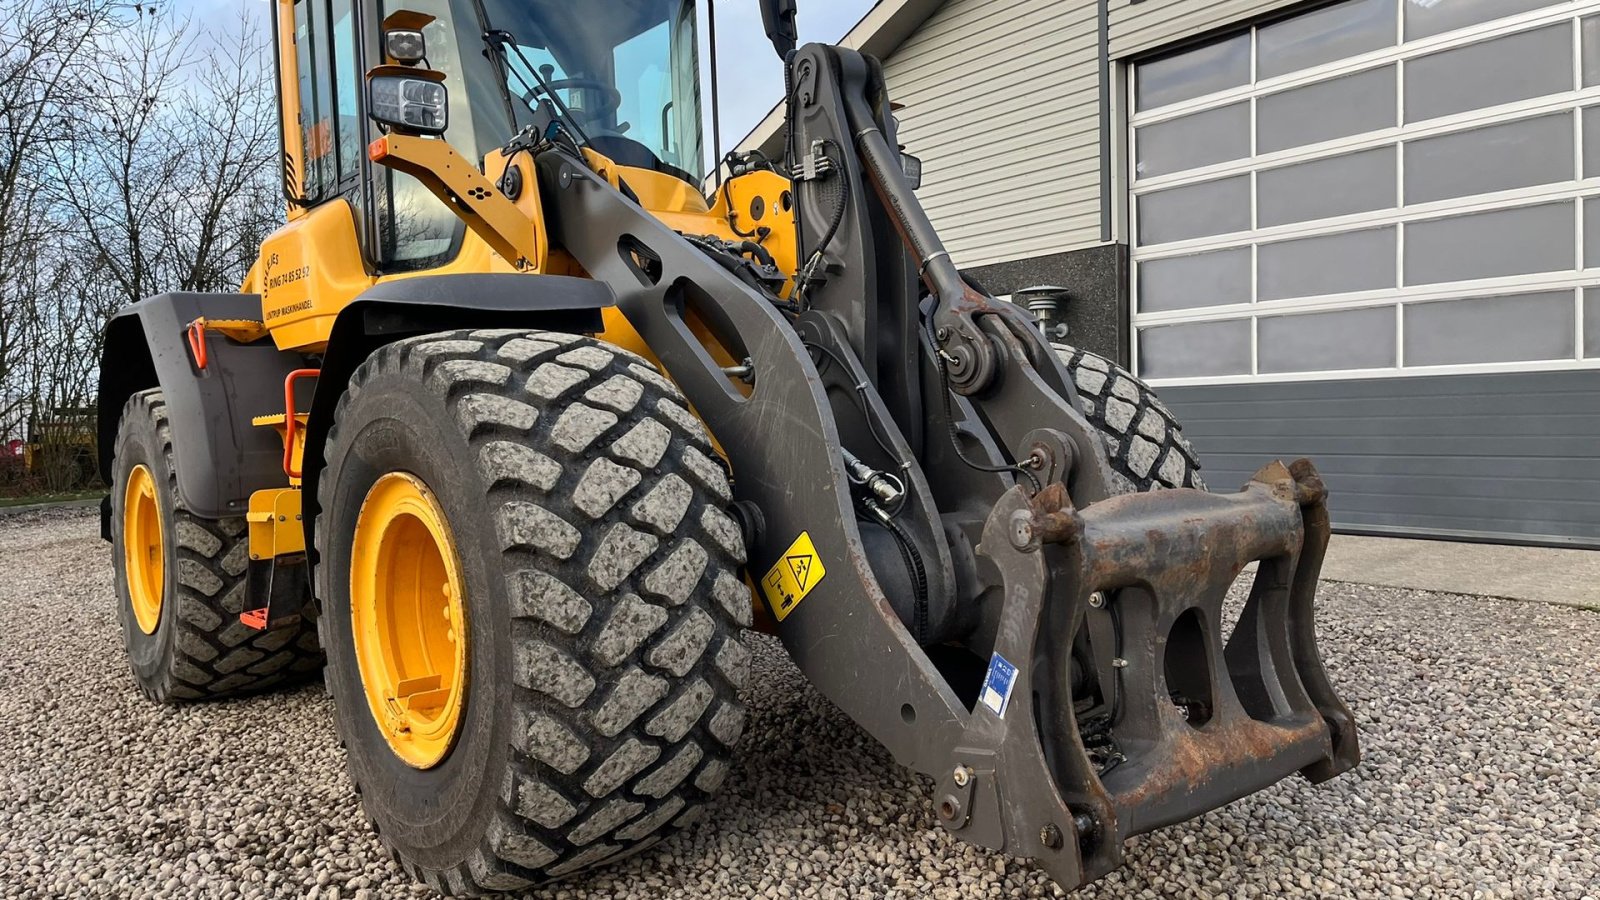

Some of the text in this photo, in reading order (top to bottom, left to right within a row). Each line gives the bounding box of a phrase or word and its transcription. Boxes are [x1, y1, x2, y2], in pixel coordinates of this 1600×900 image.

[270, 275, 281, 289] RING
[282, 273, 288, 284] 74
[289, 271, 295, 283] 85
[295, 268, 301, 280] 52
[281, 300, 313, 315] MASKINHANDEL
